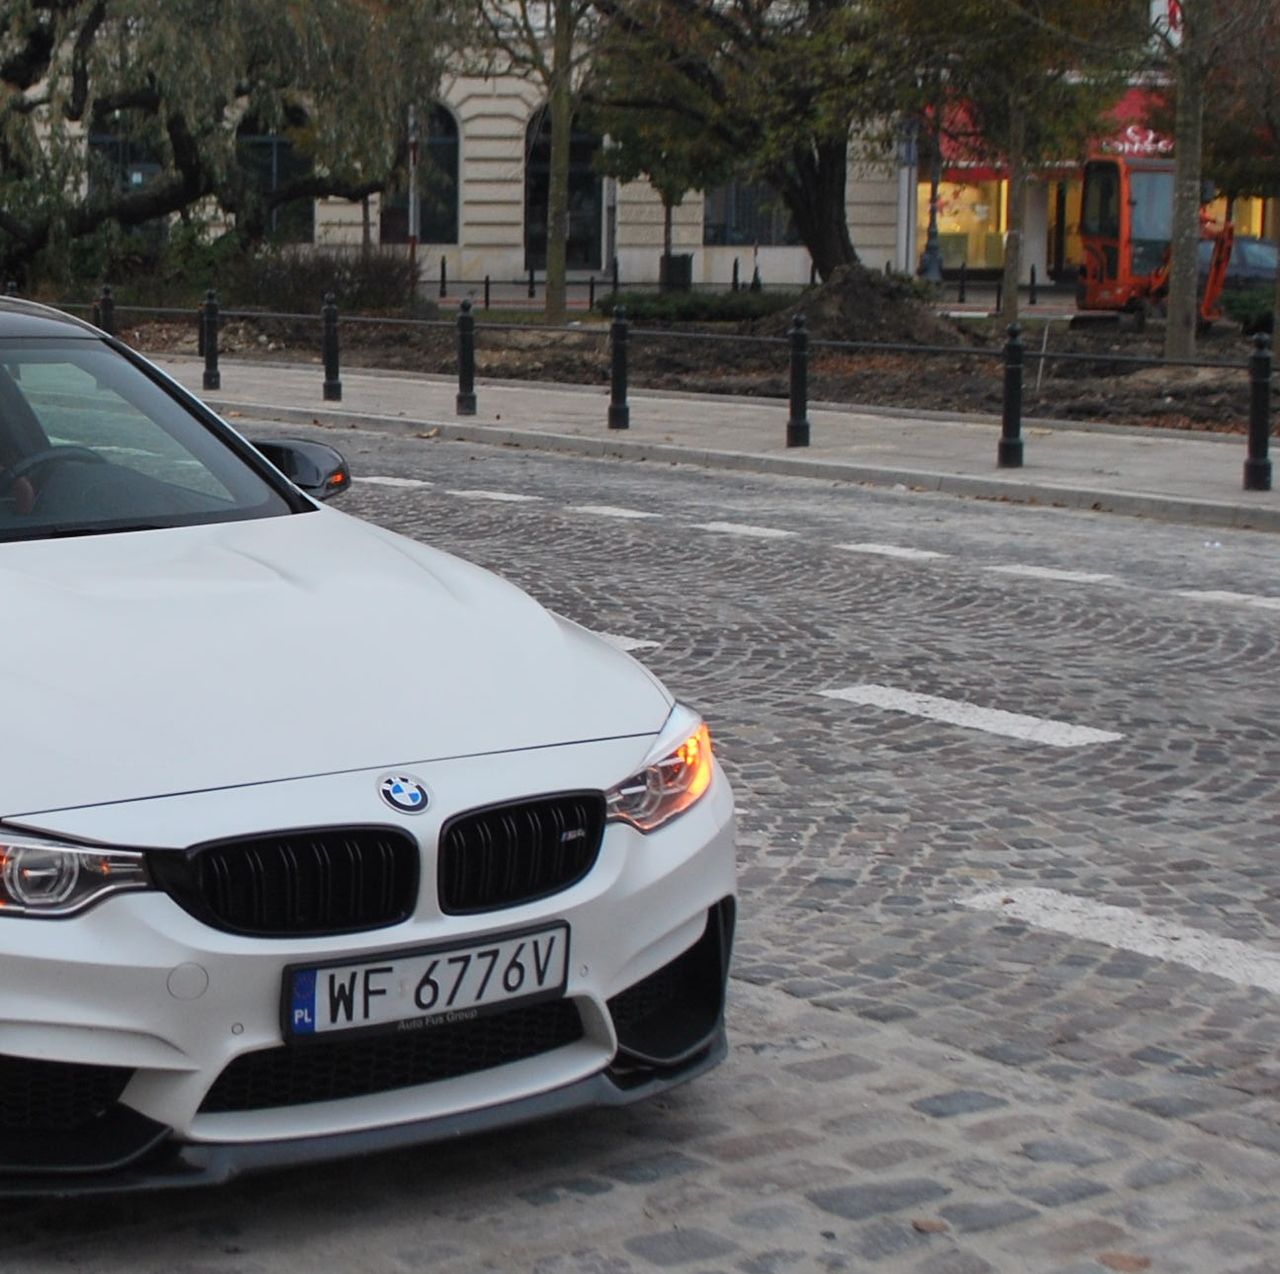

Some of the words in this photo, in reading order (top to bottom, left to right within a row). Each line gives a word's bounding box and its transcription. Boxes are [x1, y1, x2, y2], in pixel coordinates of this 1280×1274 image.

[329, 966, 394, 1024] WF
[414, 936, 555, 1011] 6776V
[294, 1008, 312, 1024] PL
[398, 1018, 423, 1032] Auto
[446, 1008, 479, 1023] Group
